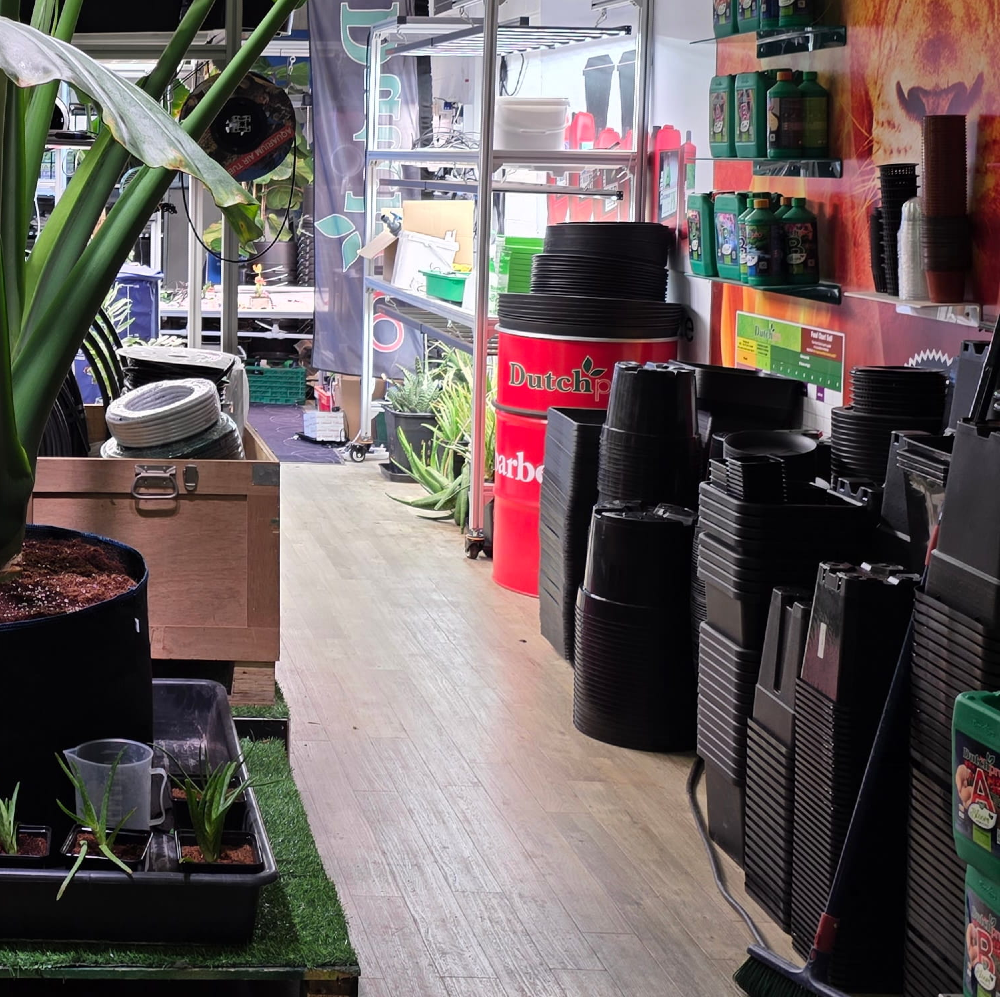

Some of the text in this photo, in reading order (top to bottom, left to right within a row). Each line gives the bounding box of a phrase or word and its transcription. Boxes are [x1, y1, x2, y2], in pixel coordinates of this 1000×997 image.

[243, 153, 258, 166] AIR
[256, 127, 292, 157] AQUARIUM
[509, 362, 612, 402] Dutchp
[971, 768, 996, 813] A
[976, 927, 996, 976] B
